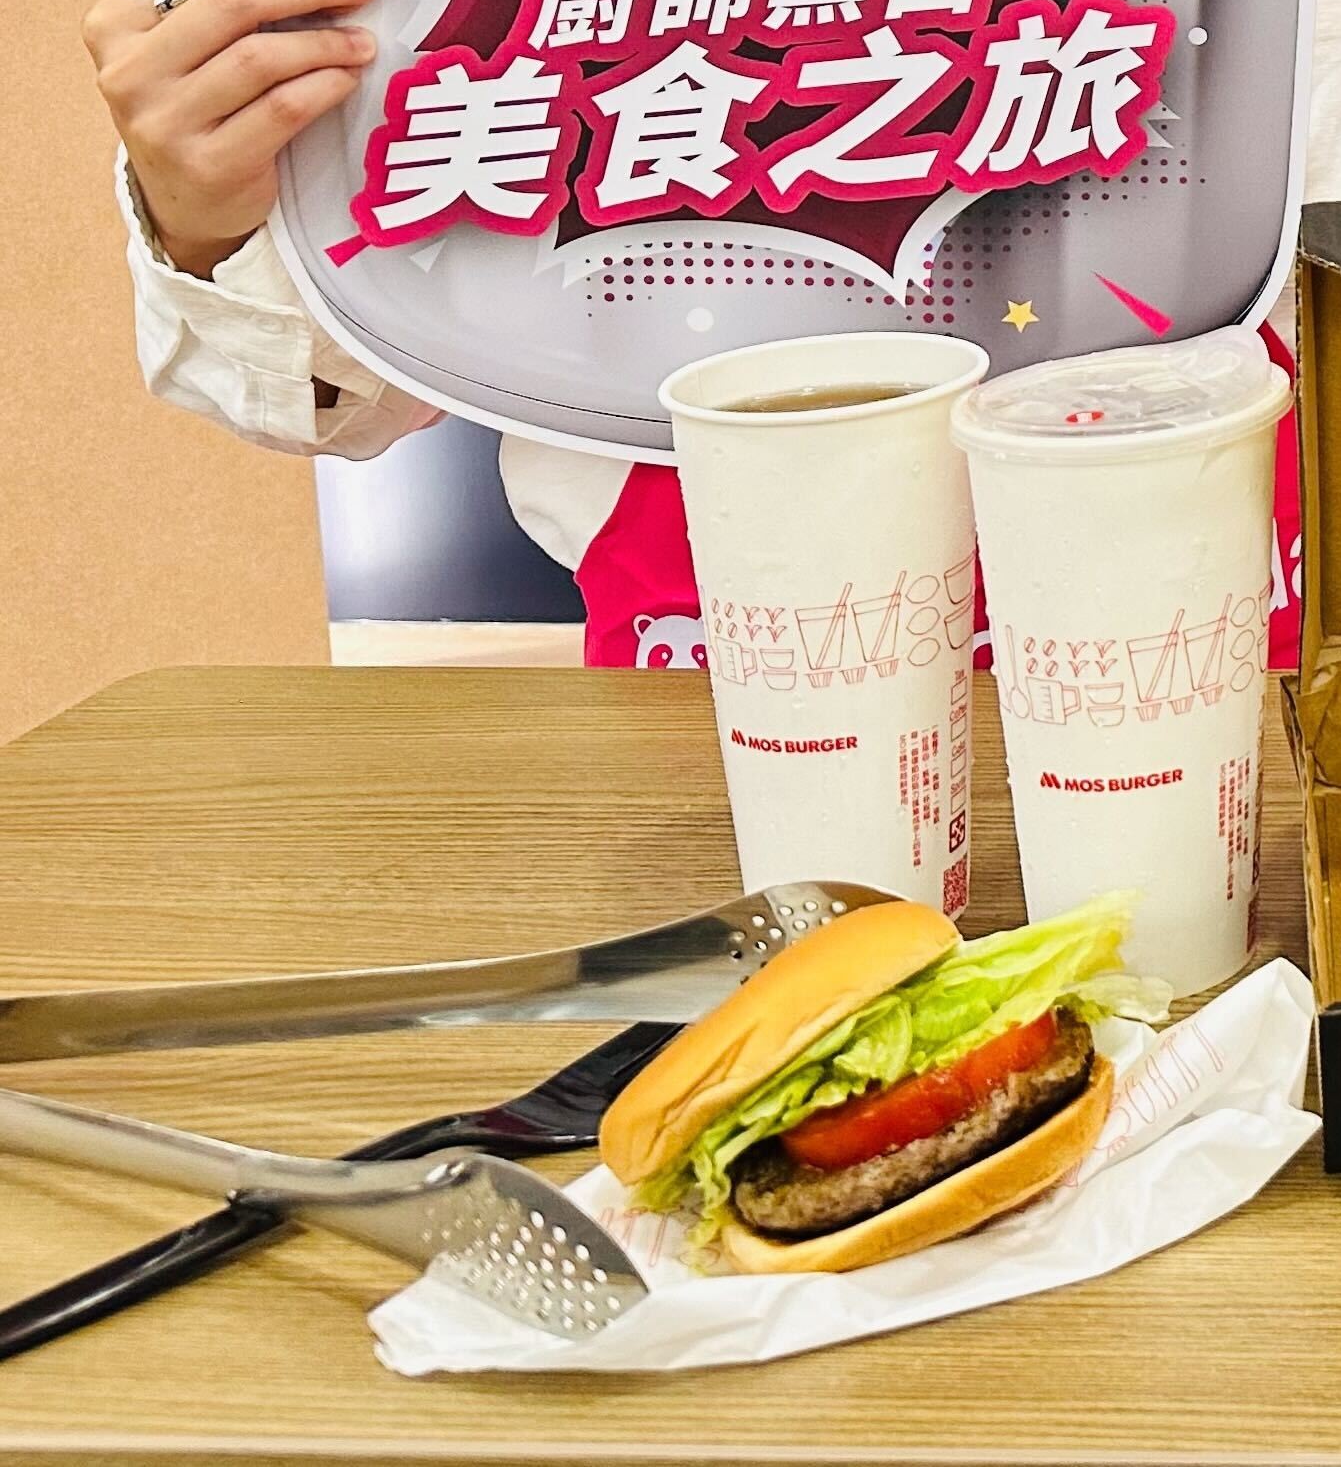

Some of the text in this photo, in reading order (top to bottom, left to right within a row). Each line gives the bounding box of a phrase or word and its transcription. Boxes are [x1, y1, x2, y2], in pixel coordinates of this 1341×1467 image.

[370, 8, 1155, 229] 美食之旅
[748, 736, 858, 754] MOS BURGER
[1064, 768, 1183, 793] MOS BURGER
